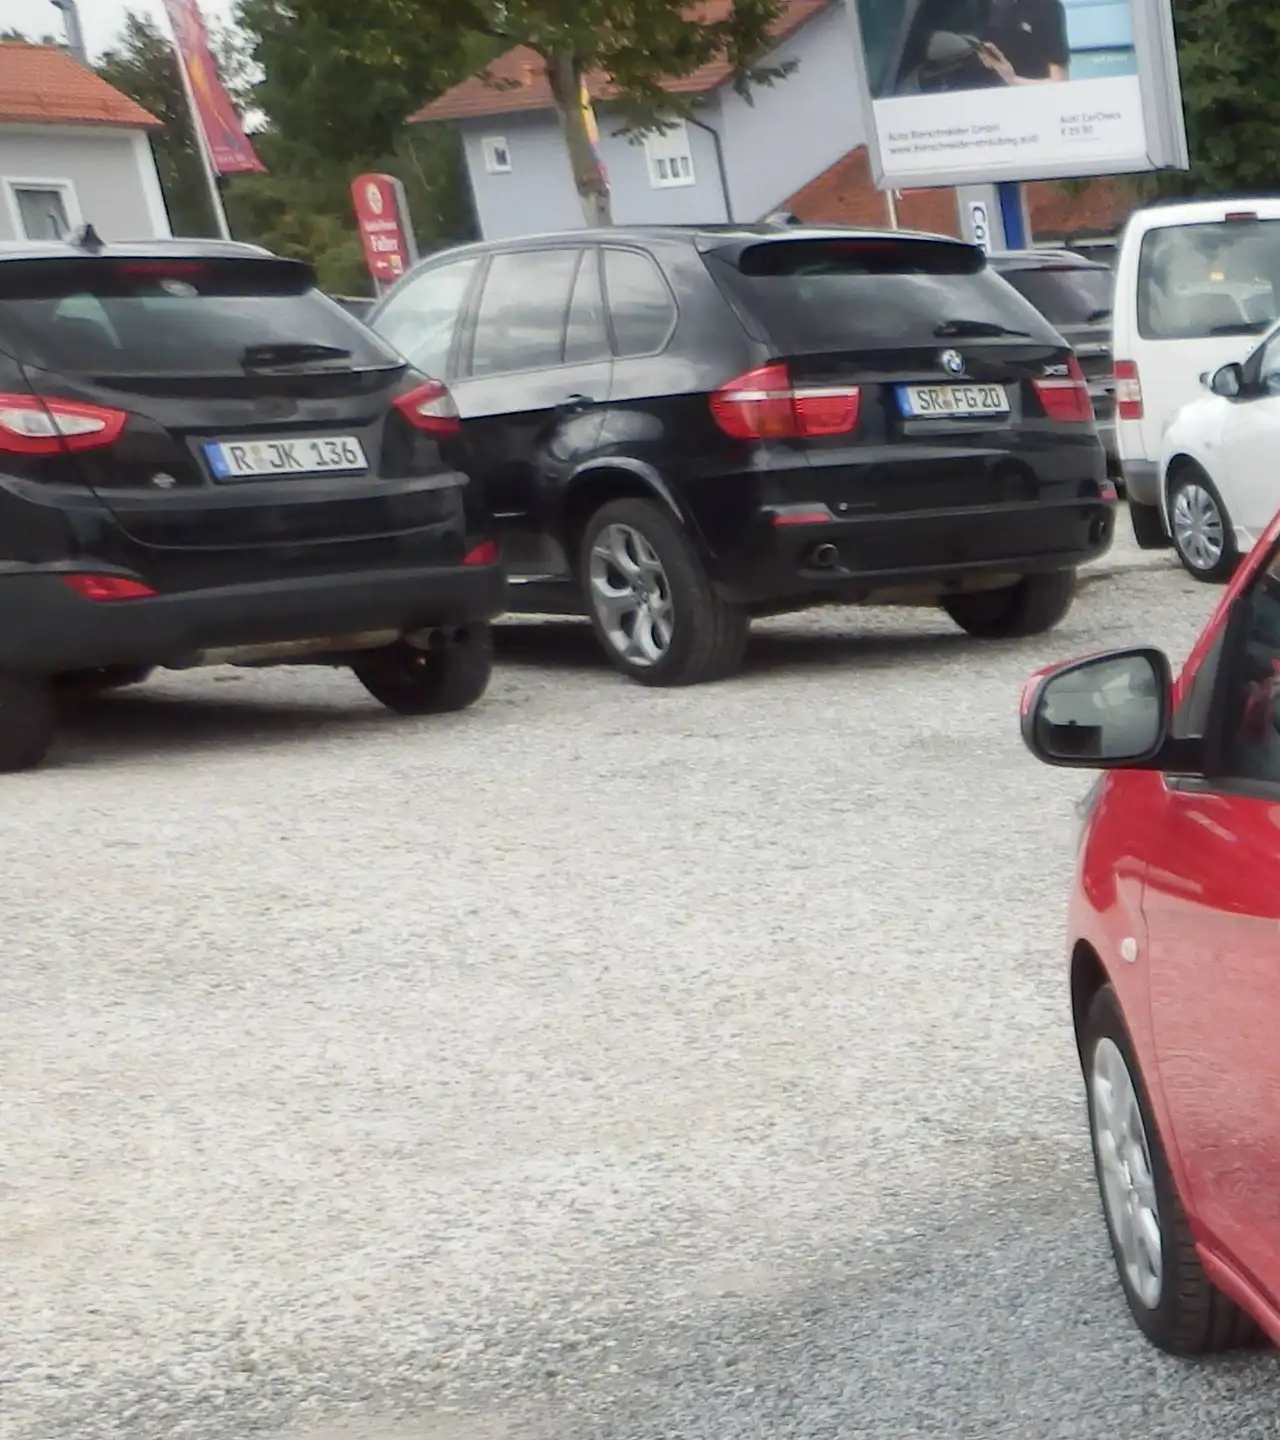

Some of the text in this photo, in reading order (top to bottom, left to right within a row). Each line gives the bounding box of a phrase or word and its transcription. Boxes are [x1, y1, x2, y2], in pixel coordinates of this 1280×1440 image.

[917, 387, 1001, 411] SR FG 20
[230, 441, 358, 471] R JK 136
